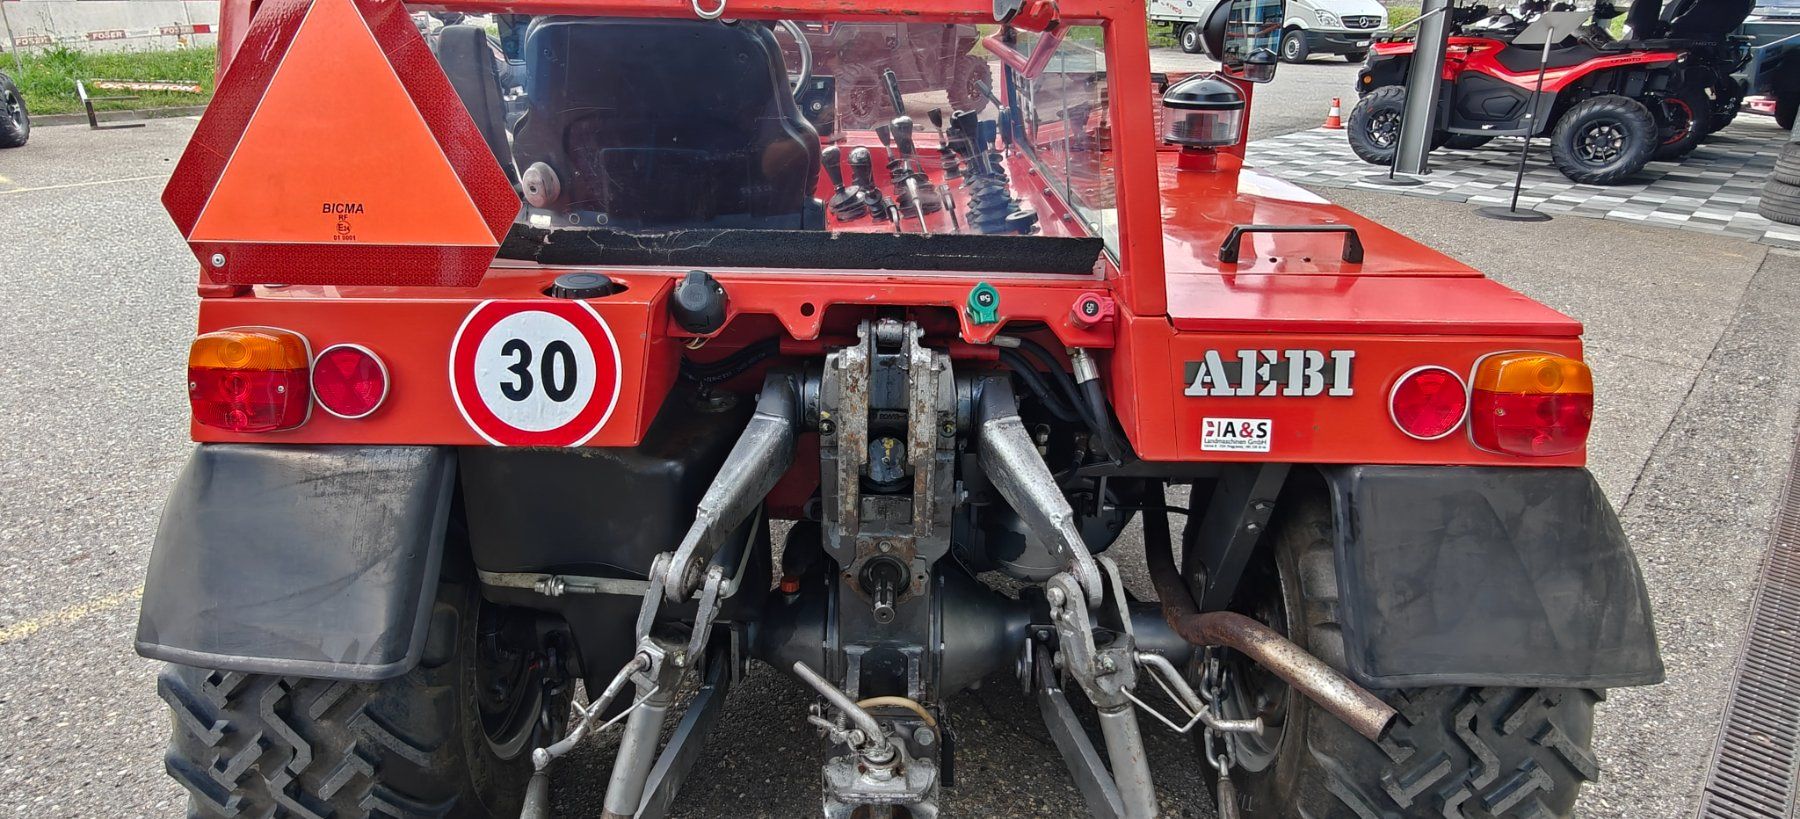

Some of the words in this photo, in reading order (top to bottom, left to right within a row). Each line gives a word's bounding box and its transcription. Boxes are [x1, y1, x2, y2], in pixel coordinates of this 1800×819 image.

[92, 31, 122, 40] FOSER
[322, 203, 364, 214] BICMA
[500, 338, 577, 403] 30
[1184, 349, 1355, 397] AEBI
